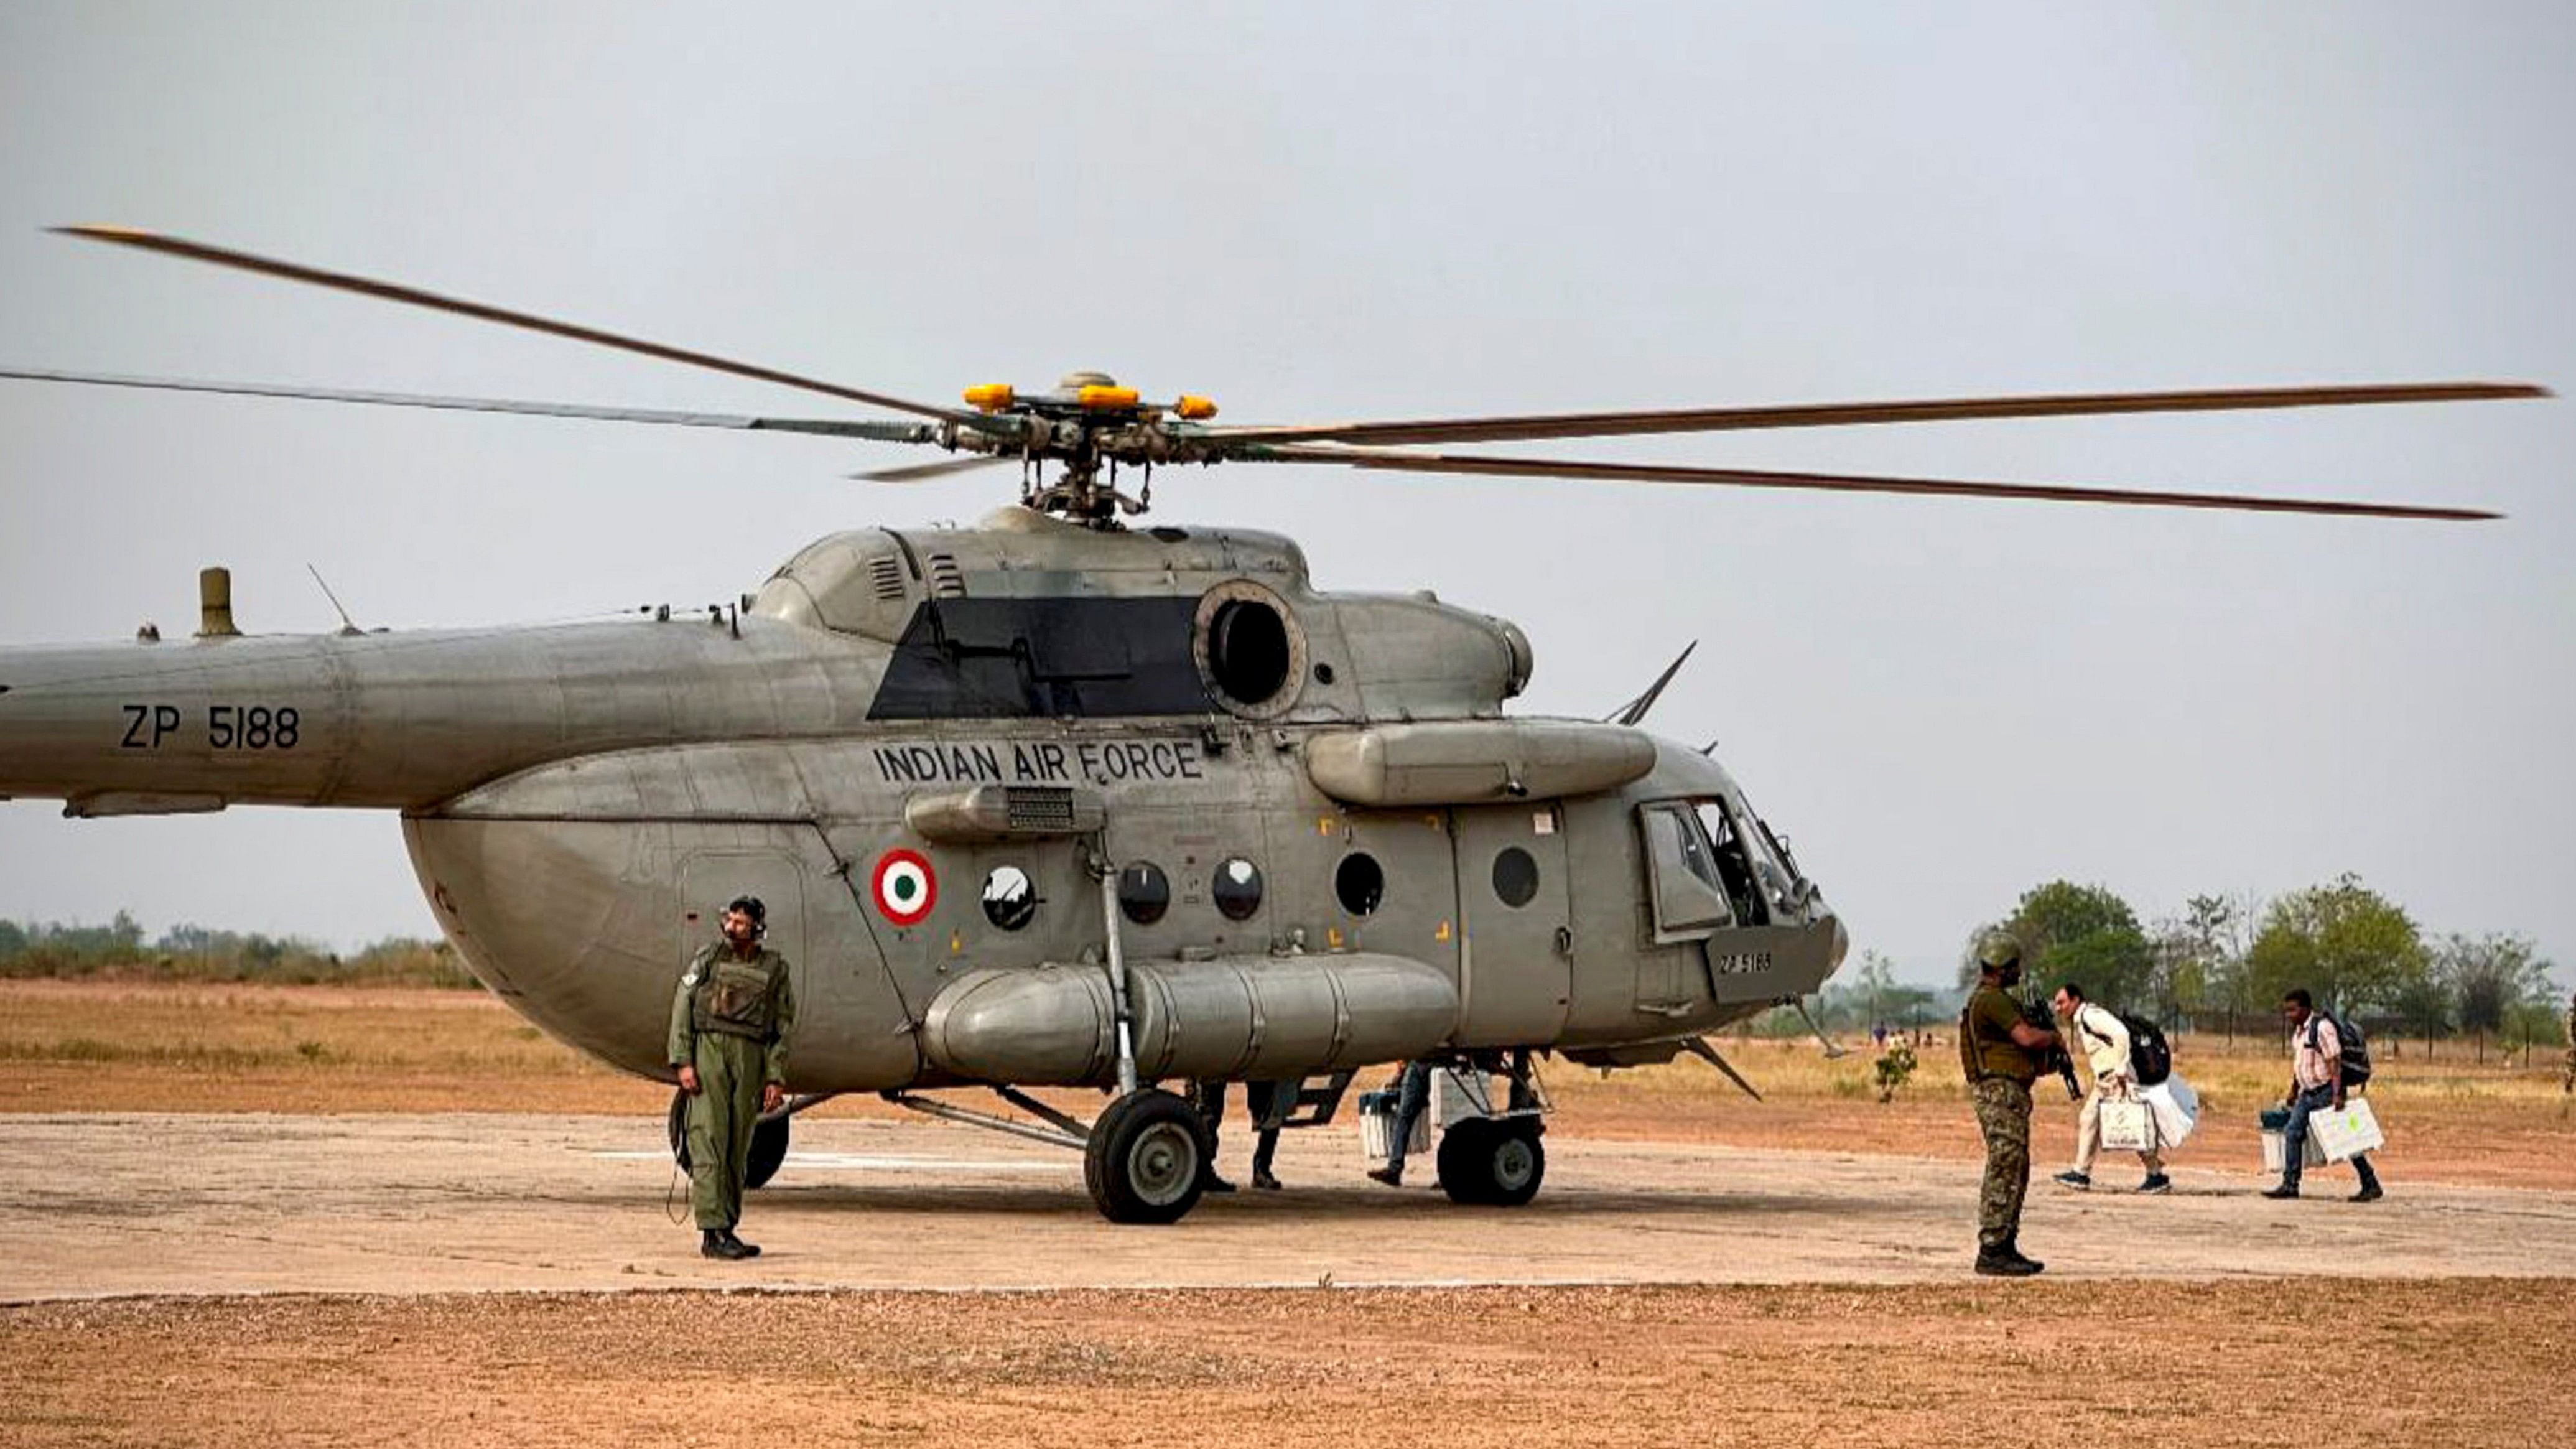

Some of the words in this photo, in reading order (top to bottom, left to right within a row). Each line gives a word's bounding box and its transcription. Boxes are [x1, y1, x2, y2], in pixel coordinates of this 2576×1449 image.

[121, 706, 180, 748] ZP
[209, 706, 299, 748] 5188
[873, 748, 1002, 781] INDIAN
[1015, 744, 1069, 780] AIR
[1081, 743, 1202, 779] FORCE
[1721, 955, 1736, 974] ZP
[1742, 952, 1771, 972] 5188
